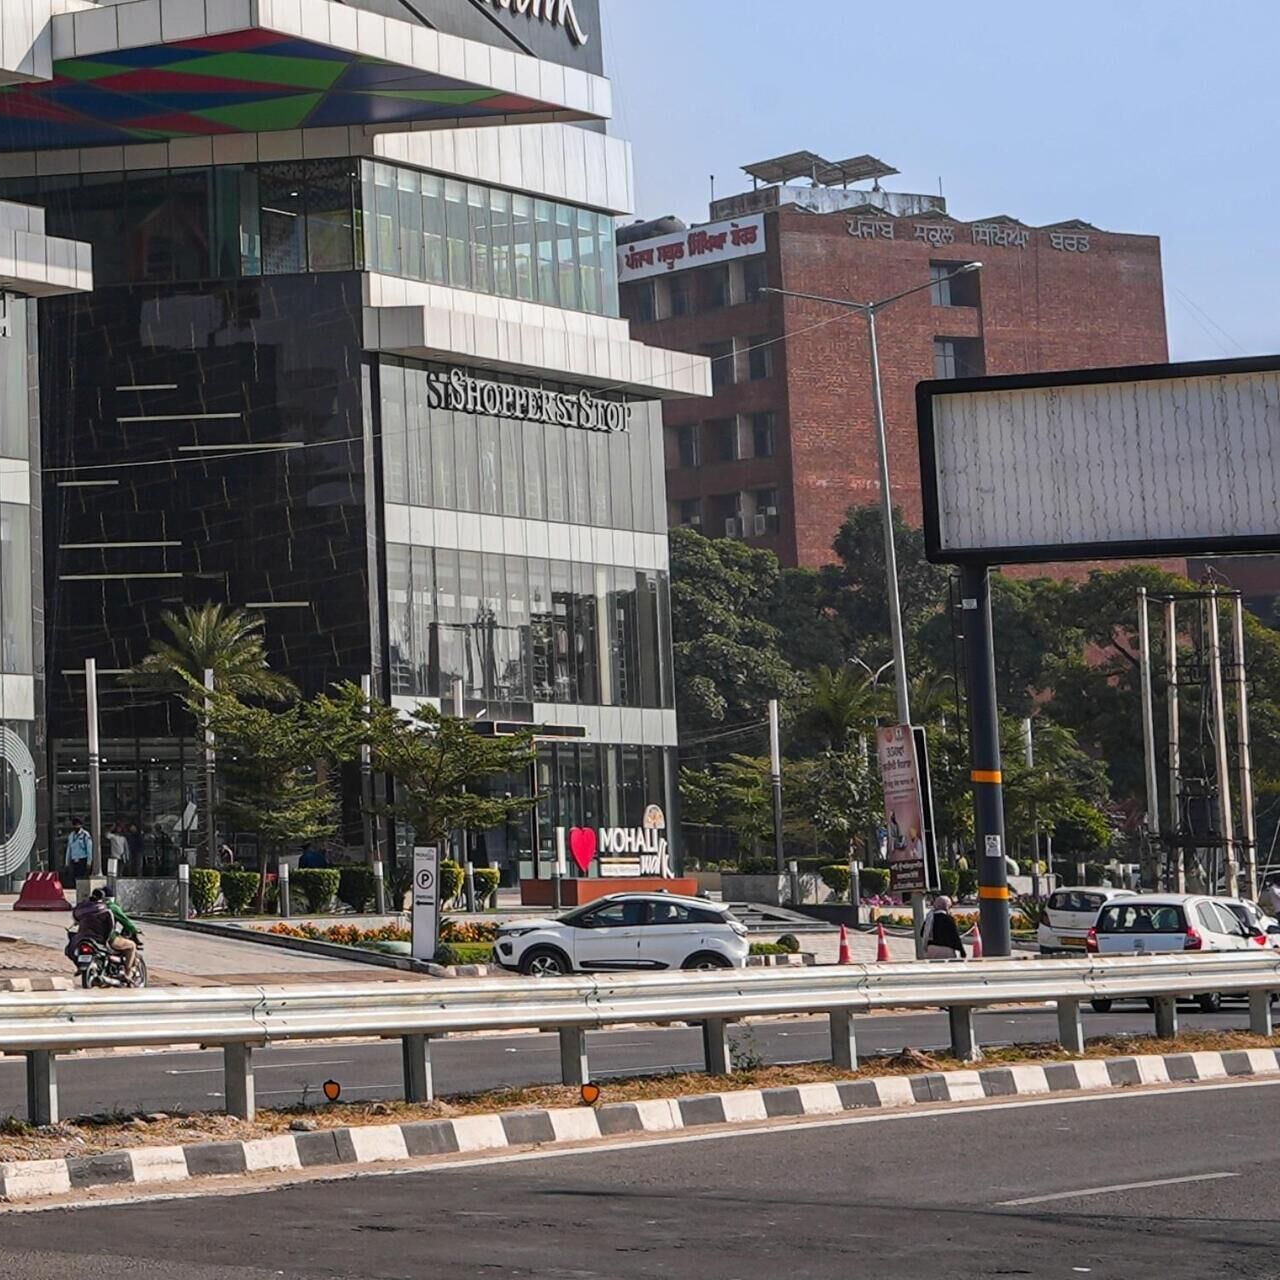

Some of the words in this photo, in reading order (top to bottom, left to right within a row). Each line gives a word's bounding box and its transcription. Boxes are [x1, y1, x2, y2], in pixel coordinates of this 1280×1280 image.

[449, 369, 566, 423] SHOPPERS
[578, 387, 632, 432] STOP
[599, 826, 659, 853] MOHALI
[640, 837, 675, 880] walk
[421, 873, 430, 885] P
